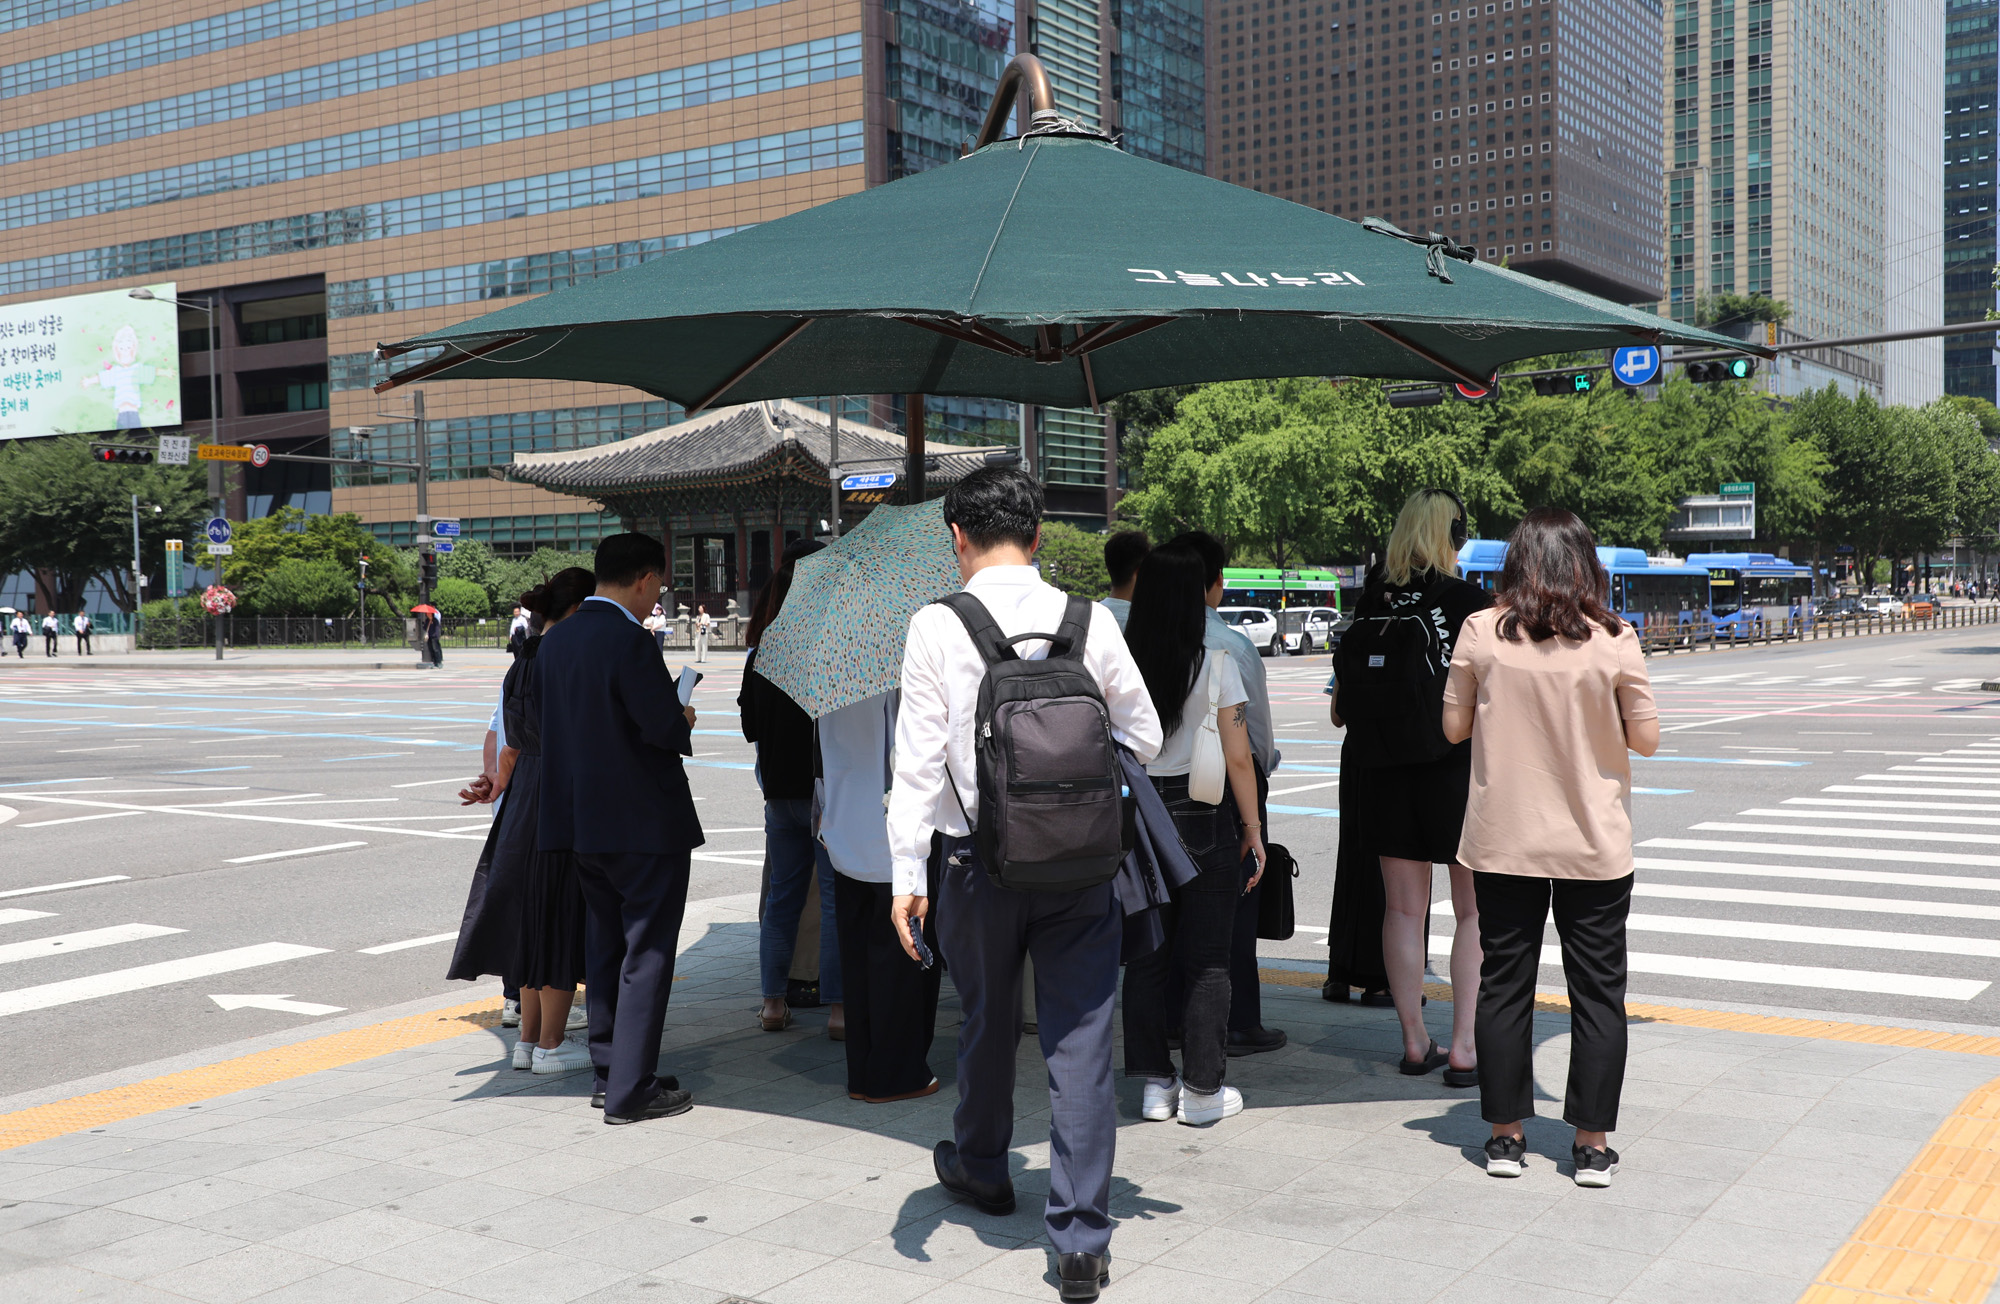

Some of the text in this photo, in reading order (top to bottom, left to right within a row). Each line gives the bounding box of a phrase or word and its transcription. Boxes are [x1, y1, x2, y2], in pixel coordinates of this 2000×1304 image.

[1127, 268, 1365, 287] 그늘나누리
[18, 319, 35, 335] 너의
[38, 315, 63, 335] 얼굴은
[11, 342, 55, 364] 장미꽃처럼
[35, 369, 61, 389] 곳까지
[160, 451, 187, 461] 직좌신호
[255, 450, 266, 461] 50
